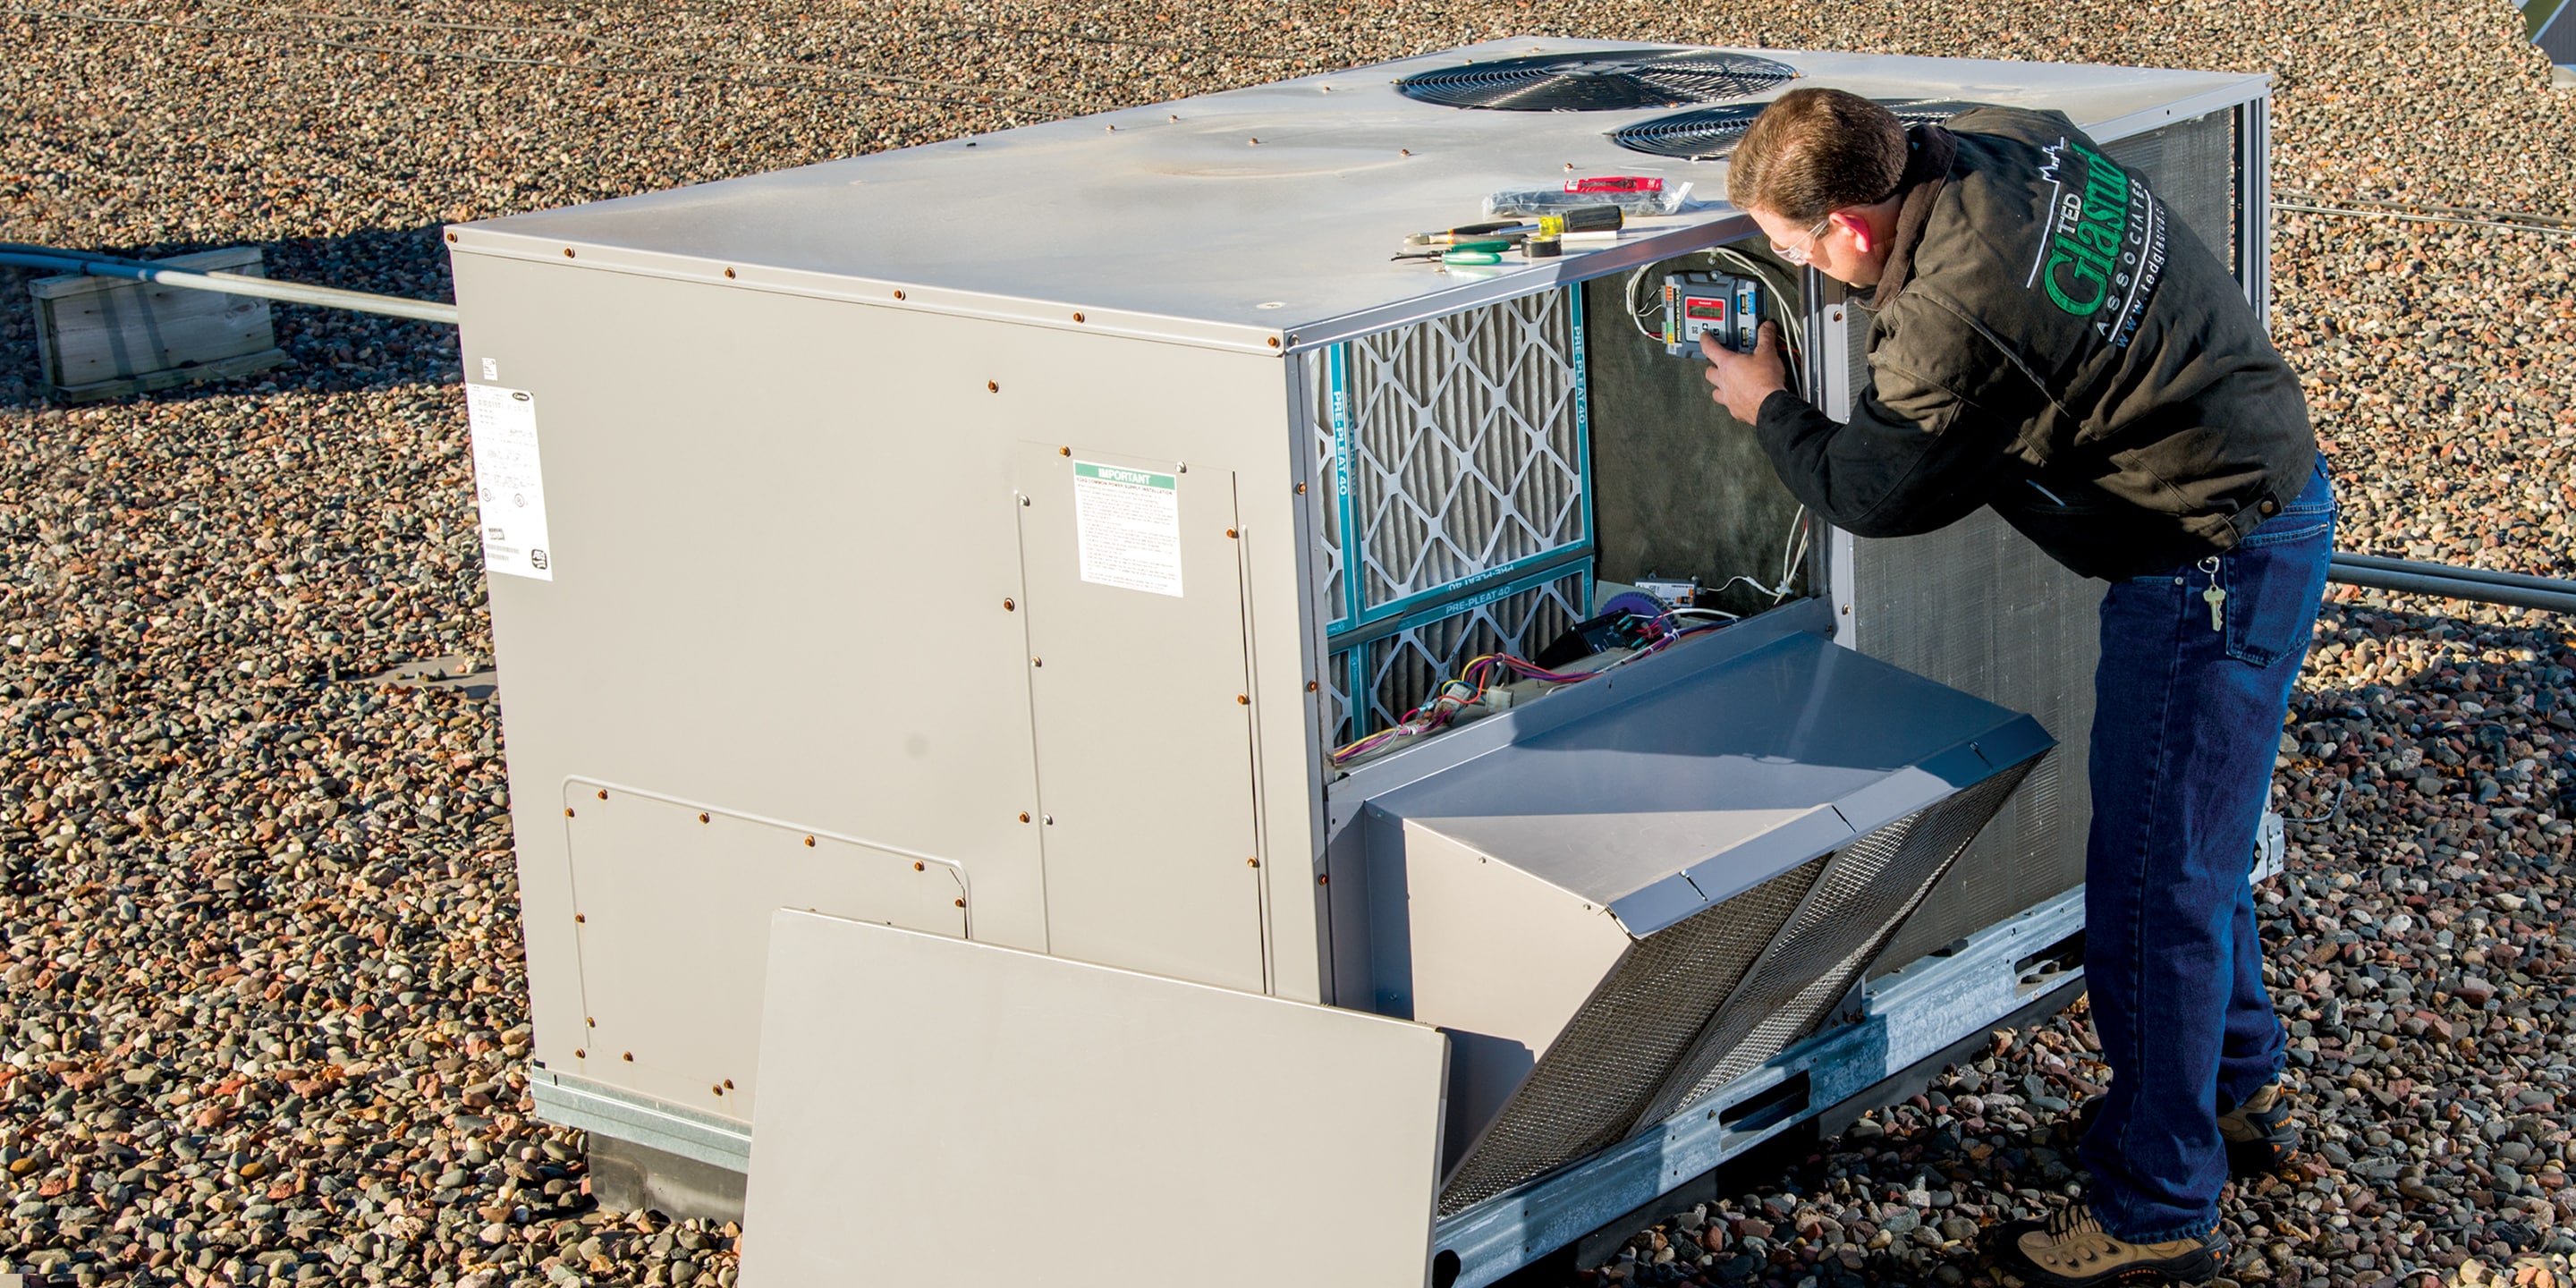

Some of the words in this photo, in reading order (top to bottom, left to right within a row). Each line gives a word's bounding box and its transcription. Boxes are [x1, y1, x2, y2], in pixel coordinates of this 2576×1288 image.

[2044, 142, 2130, 317] Glasrud
[2056, 192, 2082, 233] TED
[2097, 178, 2147, 337] ASSOCIATES
[1573, 326, 1586, 402] PRE-PLEAT
[1334, 391, 1347, 472] PRE-PLEAT
[1579, 405, 1586, 424] 40
[1098, 469, 1150, 484] IMPORTANT
[1339, 475, 1347, 496] 40
[1446, 590, 1496, 614] PRE-PLEAT
[1498, 587, 1510, 597] 40
[2119, 1268, 2157, 1279] MERRELL
